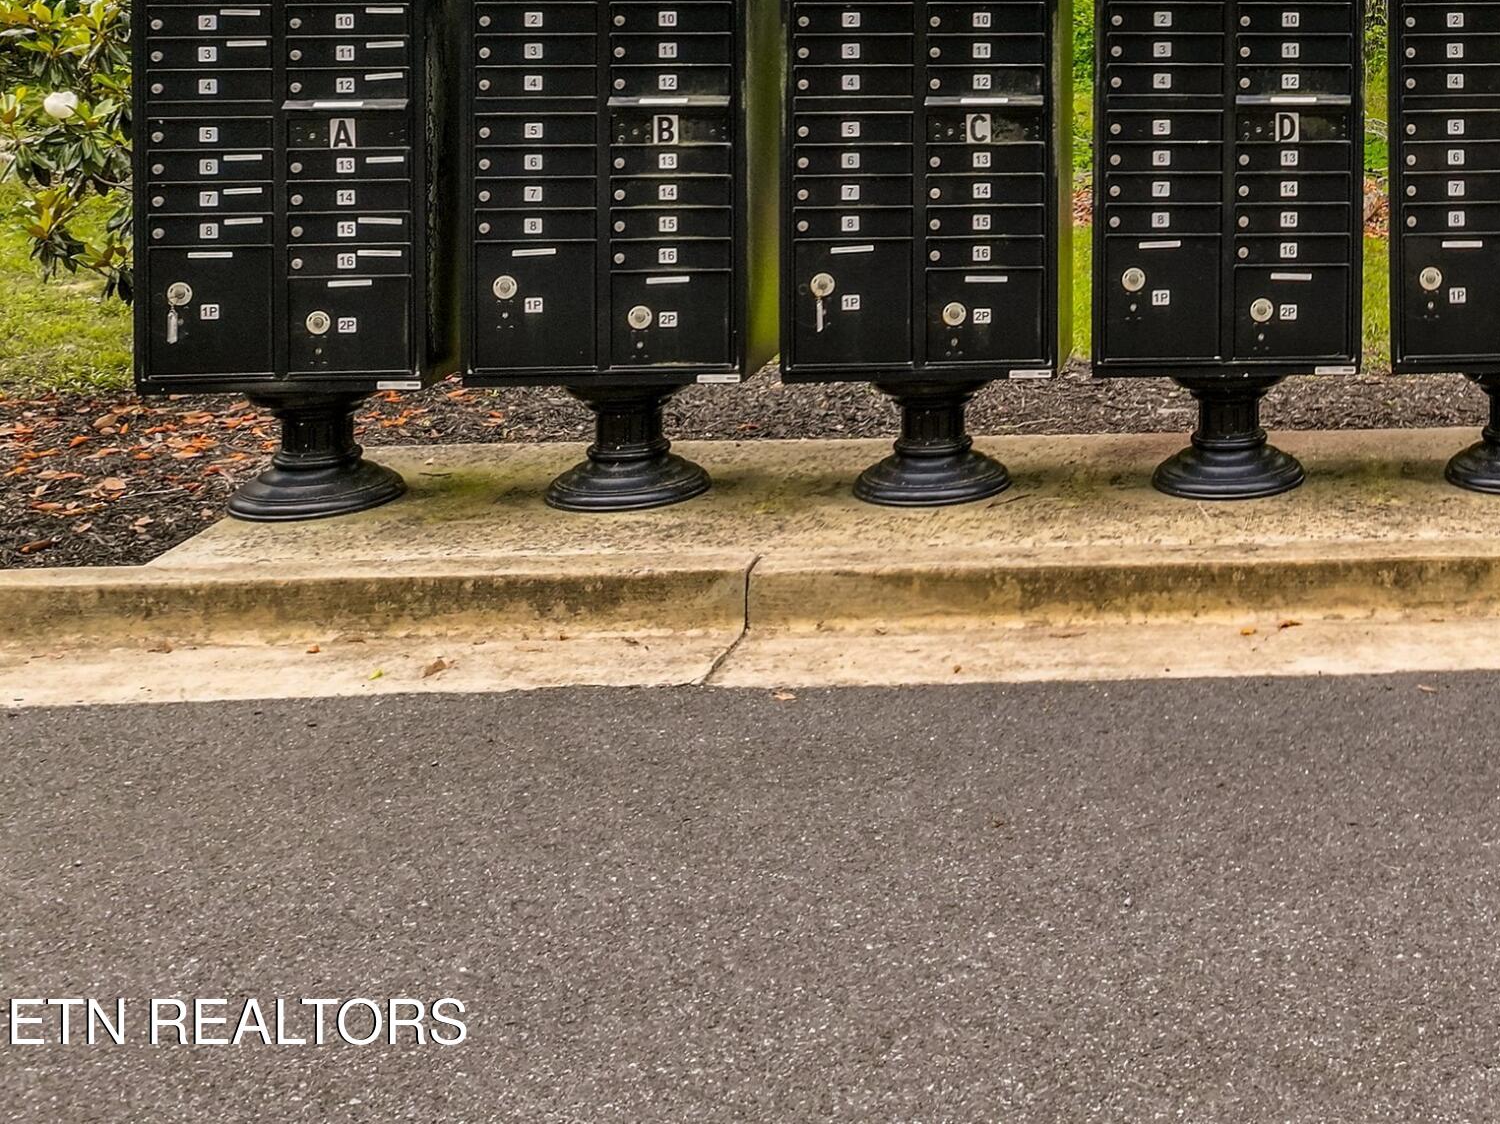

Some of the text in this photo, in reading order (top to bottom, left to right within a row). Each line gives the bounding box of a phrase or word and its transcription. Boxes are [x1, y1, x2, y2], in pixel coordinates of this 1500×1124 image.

[204, 17, 212, 28] 2
[337, 16, 352, 27] 10
[530, 14, 538, 25] 2
[660, 13, 675, 24] 10
[847, 14, 856, 25] 2
[975, 14, 989, 25] 10
[1159, 14, 1167, 24] 2
[1284, 14, 1298, 25] 10
[1452, 14, 1460, 25] 2
[204, 48, 212, 60] 3
[338, 48, 352, 58] 11
[530, 45, 538, 56] 3
[662, 45, 674, 56] 11
[847, 46, 855, 56] 3
[976, 45, 988, 56] 11
[1284, 45, 1297, 56] 11
[1451, 45, 1459, 56] 3
[204, 81, 212, 91] 4
[338, 80, 353, 91] 12
[529, 78, 538, 88] 4
[661, 77, 675, 88] 12
[847, 77, 855, 87] 4
[975, 76, 989, 87] 12
[1158, 76, 1166, 85] 4
[1284, 76, 1297, 87] 12
[1452, 76, 1459, 86] 4
[529, 125, 538, 136] 5
[656, 116, 676, 144] B
[847, 124, 855, 135] 5
[969, 114, 988, 142] C
[1158, 122, 1166, 132] 5
[1278, 113, 1296, 141] D
[1452, 121, 1460, 132] 5
[204, 129, 212, 140] 5
[332, 119, 354, 148] A
[529, 156, 538, 168] 6
[661, 155, 675, 166] 13
[975, 154, 989, 165] 13
[1283, 152, 1296, 163] 13
[1452, 152, 1460, 162] 6
[205, 161, 213, 172] 6
[338, 160, 353, 171] 13
[529, 188, 537, 199] 7
[661, 187, 675, 197] 14
[847, 187, 854, 197] 7
[975, 186, 989, 196] 14
[1157, 184, 1166, 194] 7
[1283, 184, 1296, 194] 14
[1452, 183, 1461, 193] 7
[204, 193, 213, 204] 7
[339, 192, 353, 202] 14
[661, 218, 675, 230] 15
[975, 216, 989, 228] 15
[1283, 214, 1296, 225] 15
[205, 225, 213, 236] 8
[338, 224, 354, 235] 15
[660, 250, 675, 261] 16
[975, 248, 989, 259] 16
[1282, 244, 1296, 256] 16
[338, 255, 354, 267] 16
[1154, 292, 1168, 303] 1P
[1451, 290, 1465, 301] 1P
[526, 300, 542, 310] 1P
[843, 297, 859, 308] 1P
[202, 306, 218, 317] 1P
[975, 311, 990, 322] 2P
[1281, 307, 1296, 317] 2P
[660, 314, 676, 325] 2P
[339, 320, 355, 331] 2P
